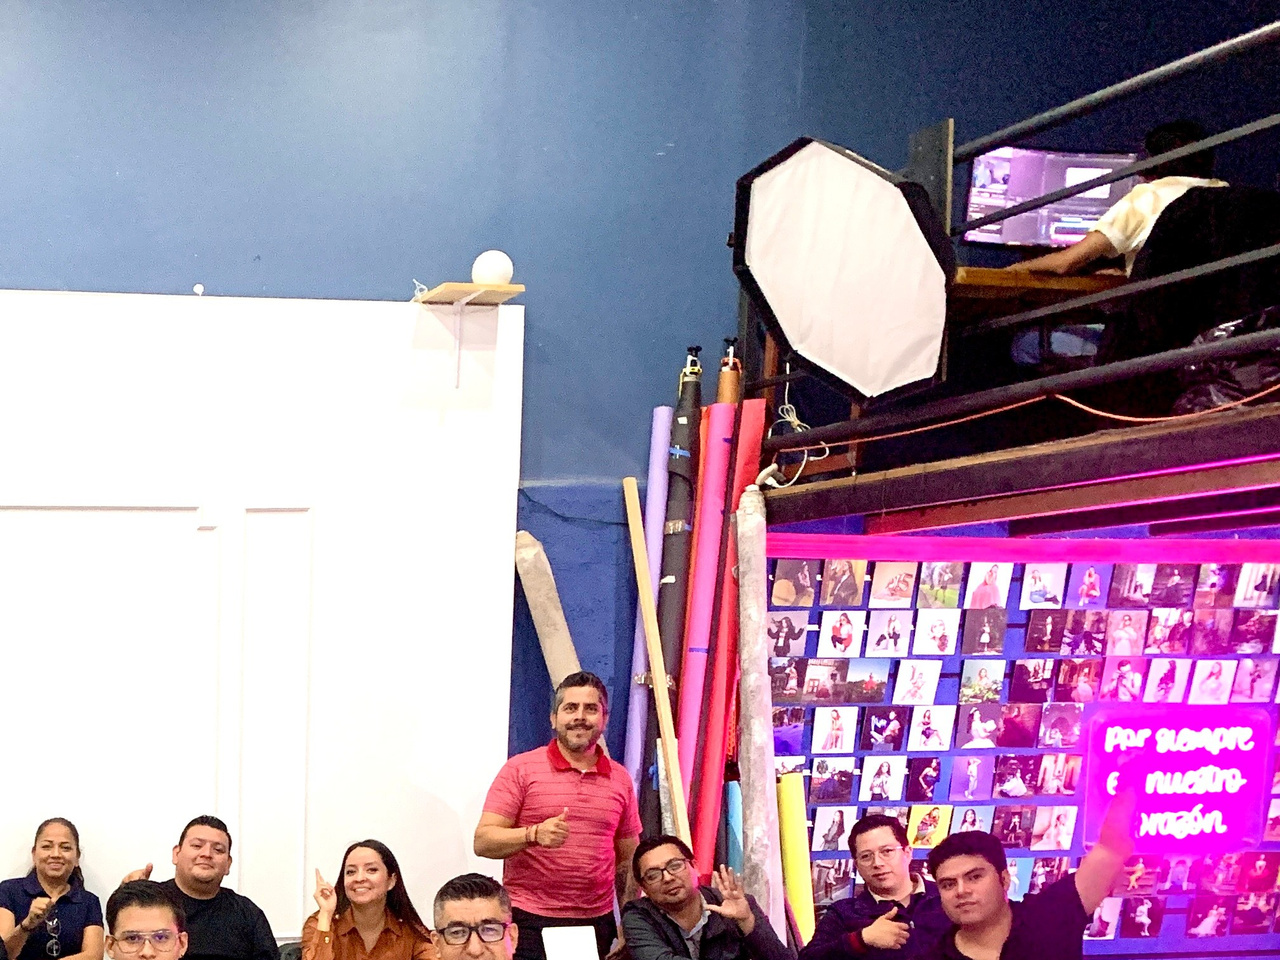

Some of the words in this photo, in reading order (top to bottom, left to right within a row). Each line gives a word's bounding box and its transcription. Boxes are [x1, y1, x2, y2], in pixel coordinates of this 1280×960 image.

[1155, 727, 1255, 755] siempre
[1145, 764, 1247, 794] nuestro
[1136, 803, 1228, 839] razón
